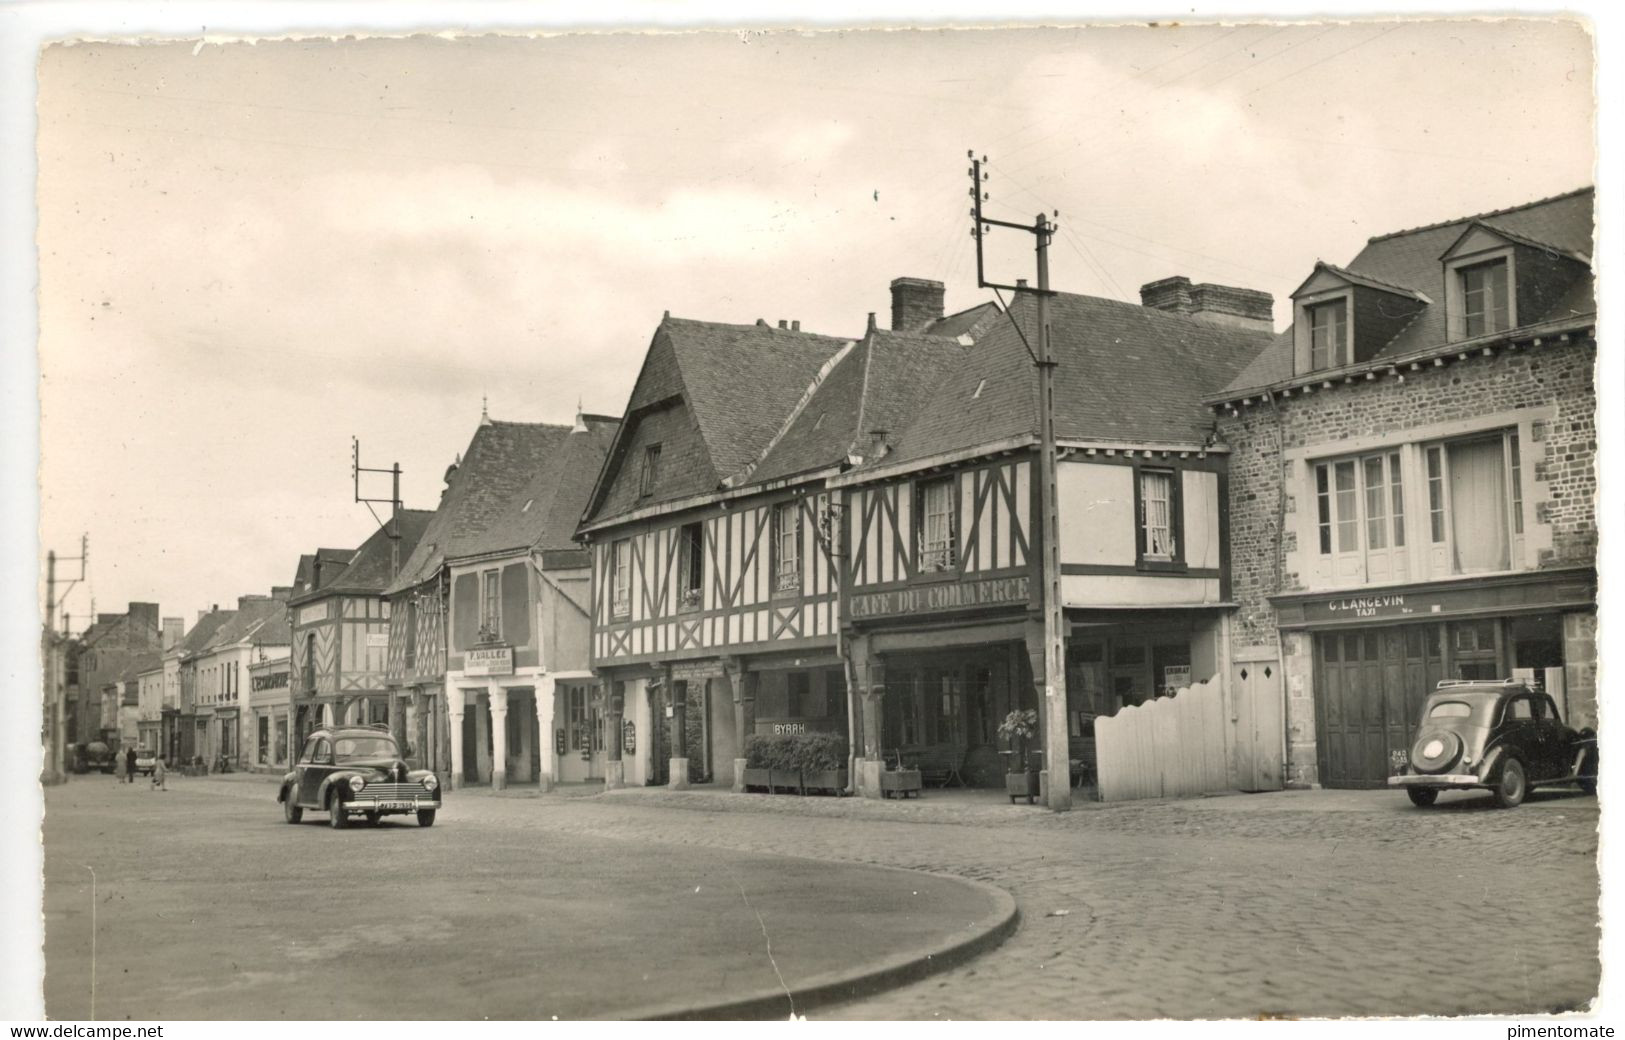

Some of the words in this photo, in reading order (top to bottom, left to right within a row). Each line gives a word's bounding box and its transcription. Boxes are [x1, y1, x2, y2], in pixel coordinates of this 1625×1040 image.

[897, 590, 921, 613] DU
[927, 577, 1031, 609] COMMERCE
[1356, 607, 1377, 617] TAXI
[774, 723, 805, 736] BYRRH
